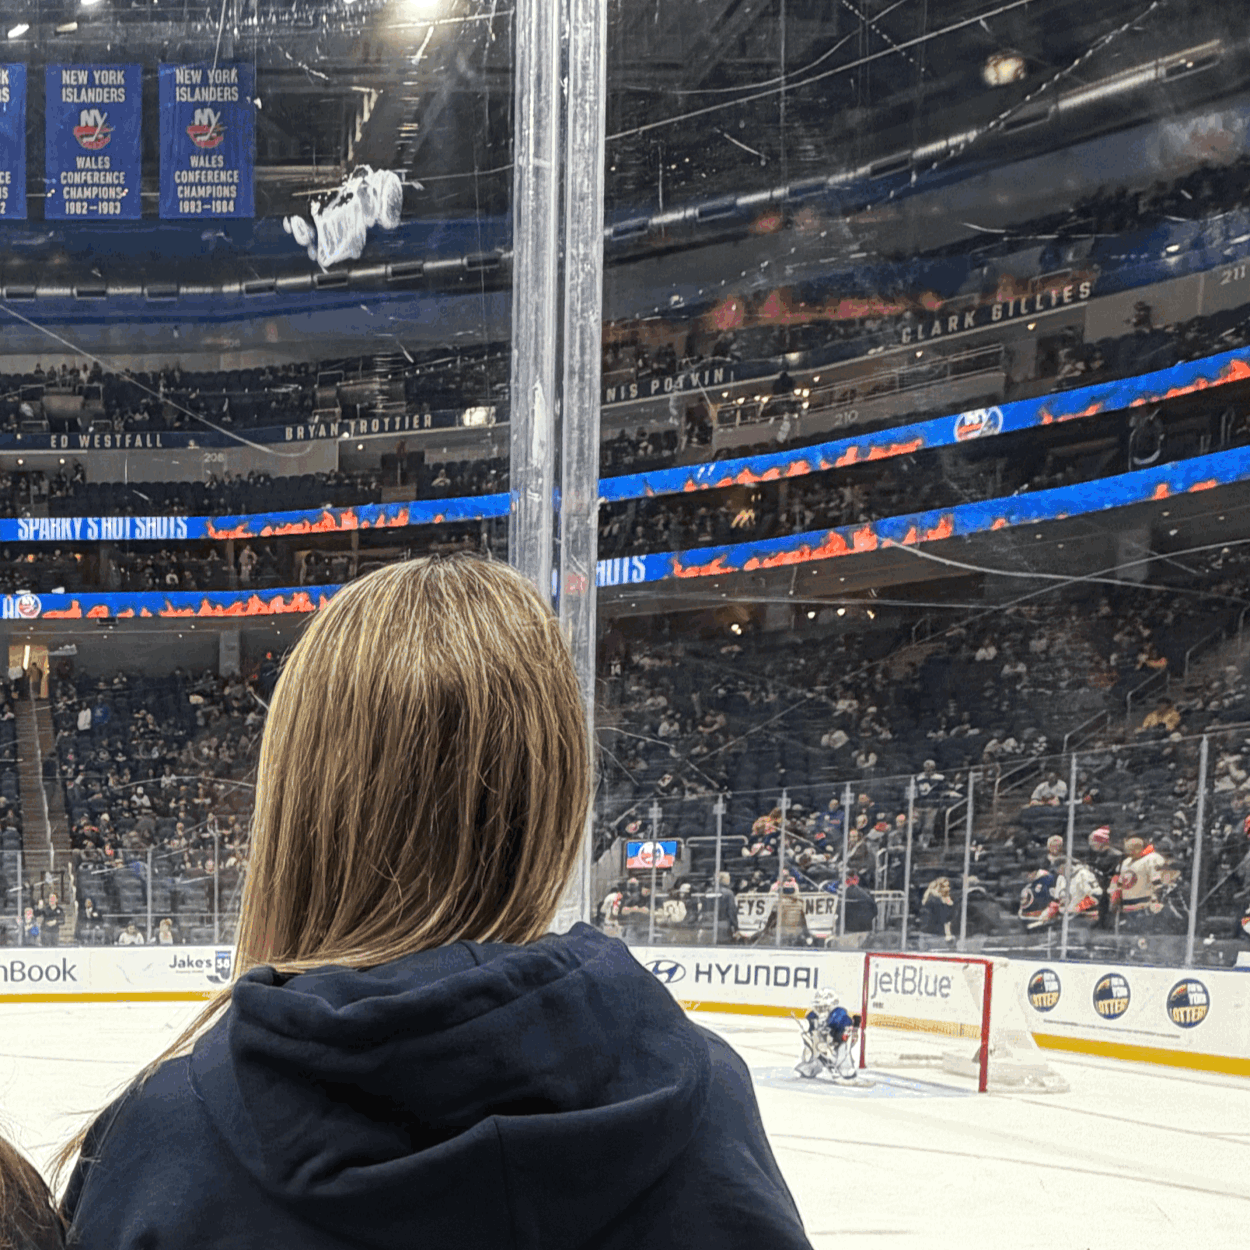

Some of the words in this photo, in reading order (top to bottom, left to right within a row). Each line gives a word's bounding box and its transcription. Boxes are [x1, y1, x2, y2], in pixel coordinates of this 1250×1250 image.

[62, 70, 87, 85] NEW
[93, 70, 125, 85] YORK
[175, 69, 201, 84] NEW
[207, 68, 238, 84] YORK
[62, 87, 125, 103] ISLANDERS
[176, 87, 239, 102] ISLANDERS
[76, 156, 111, 169] WALES
[190, 155, 224, 168] WALES
[60, 171, 126, 185] CONFERENCE
[174, 170, 239, 184] CONFERENCE
[63, 187, 122, 199] CHAMPIONS
[177, 185, 237, 199] CHAMPIONS
[1220, 266, 1247, 286] 211
[901, 310, 976, 344] CLARK
[992, 281, 1091, 322] GILLIES
[606, 383, 638, 402] NIS
[285, 422, 339, 441] BRYAN
[350, 414, 432, 437] TROTTIER
[50, 435, 69, 449] ED
[78, 433, 163, 449] WESTFALL
[695, 963, 819, 989] HYUNDAI
[870, 963, 951, 1000] jetBlue
